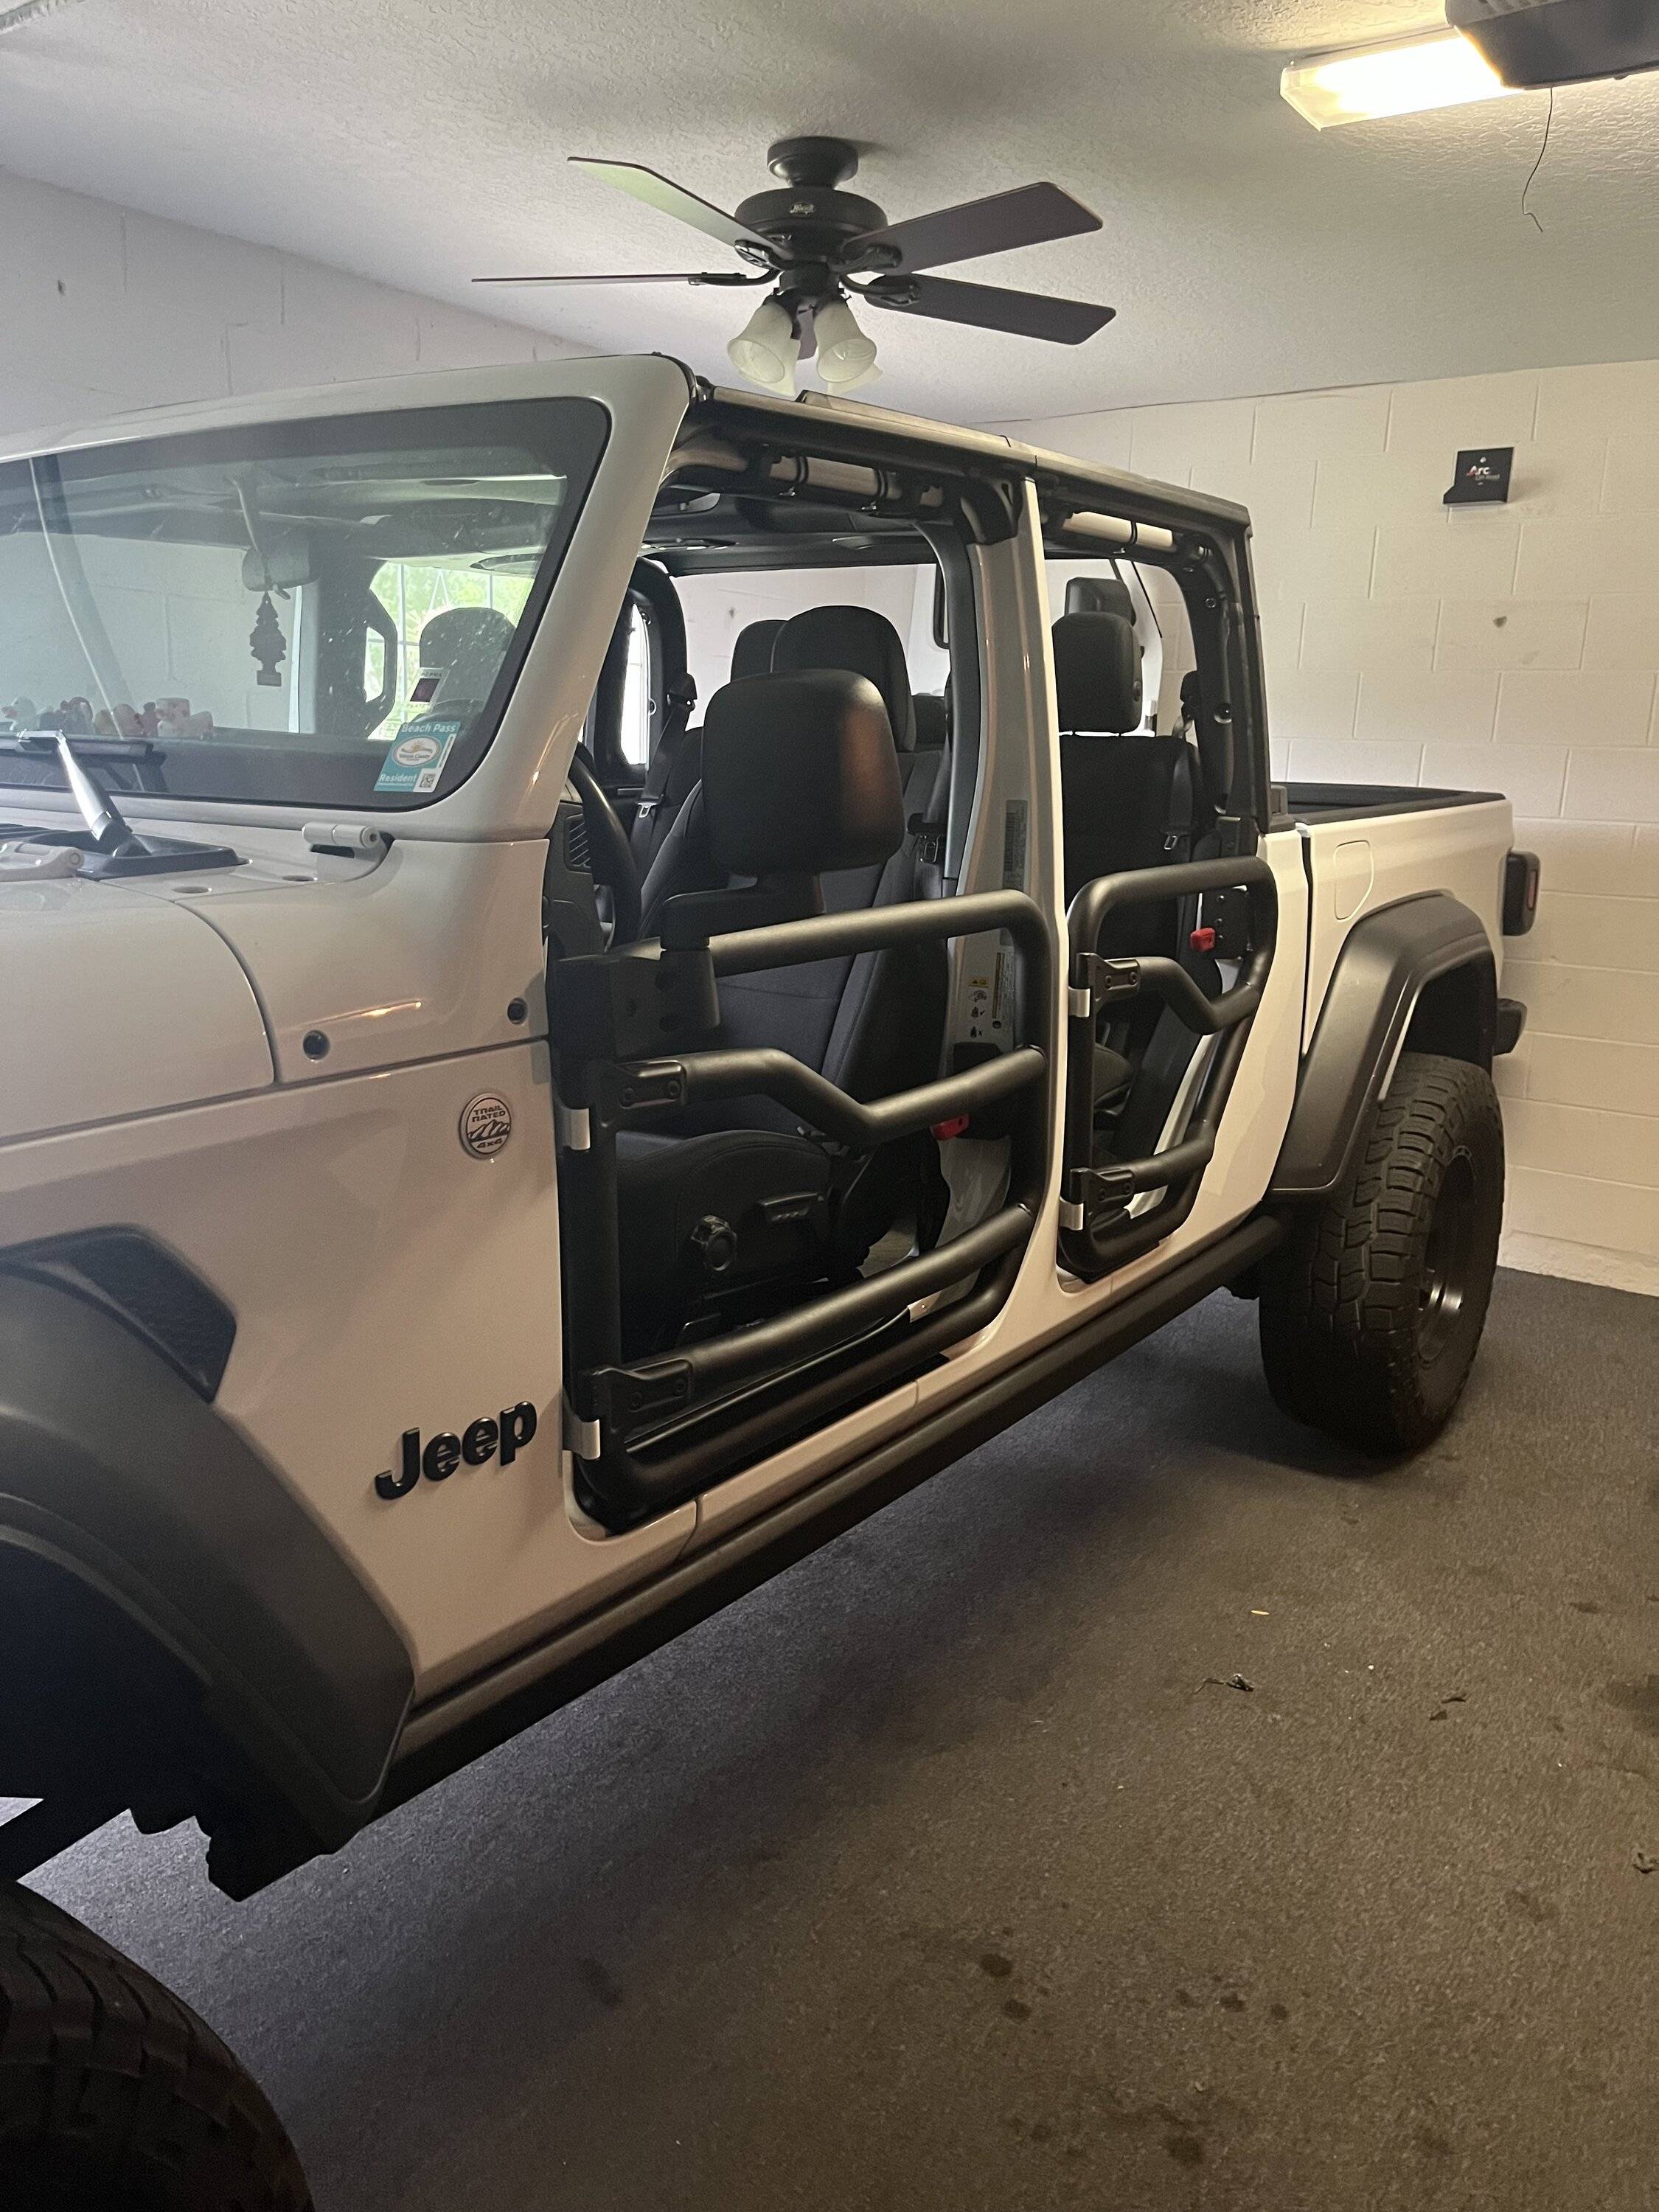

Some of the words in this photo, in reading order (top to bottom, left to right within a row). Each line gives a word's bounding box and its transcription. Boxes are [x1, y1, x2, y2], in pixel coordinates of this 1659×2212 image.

[401, 723, 431, 733] Beach
[433, 723, 456, 733] Pass
[378, 773, 417, 782] Resident
[472, 1110, 506, 1122] RATED
[473, 1105, 503, 1116] TRAIL
[375, 1401, 537, 1500] Jeep
